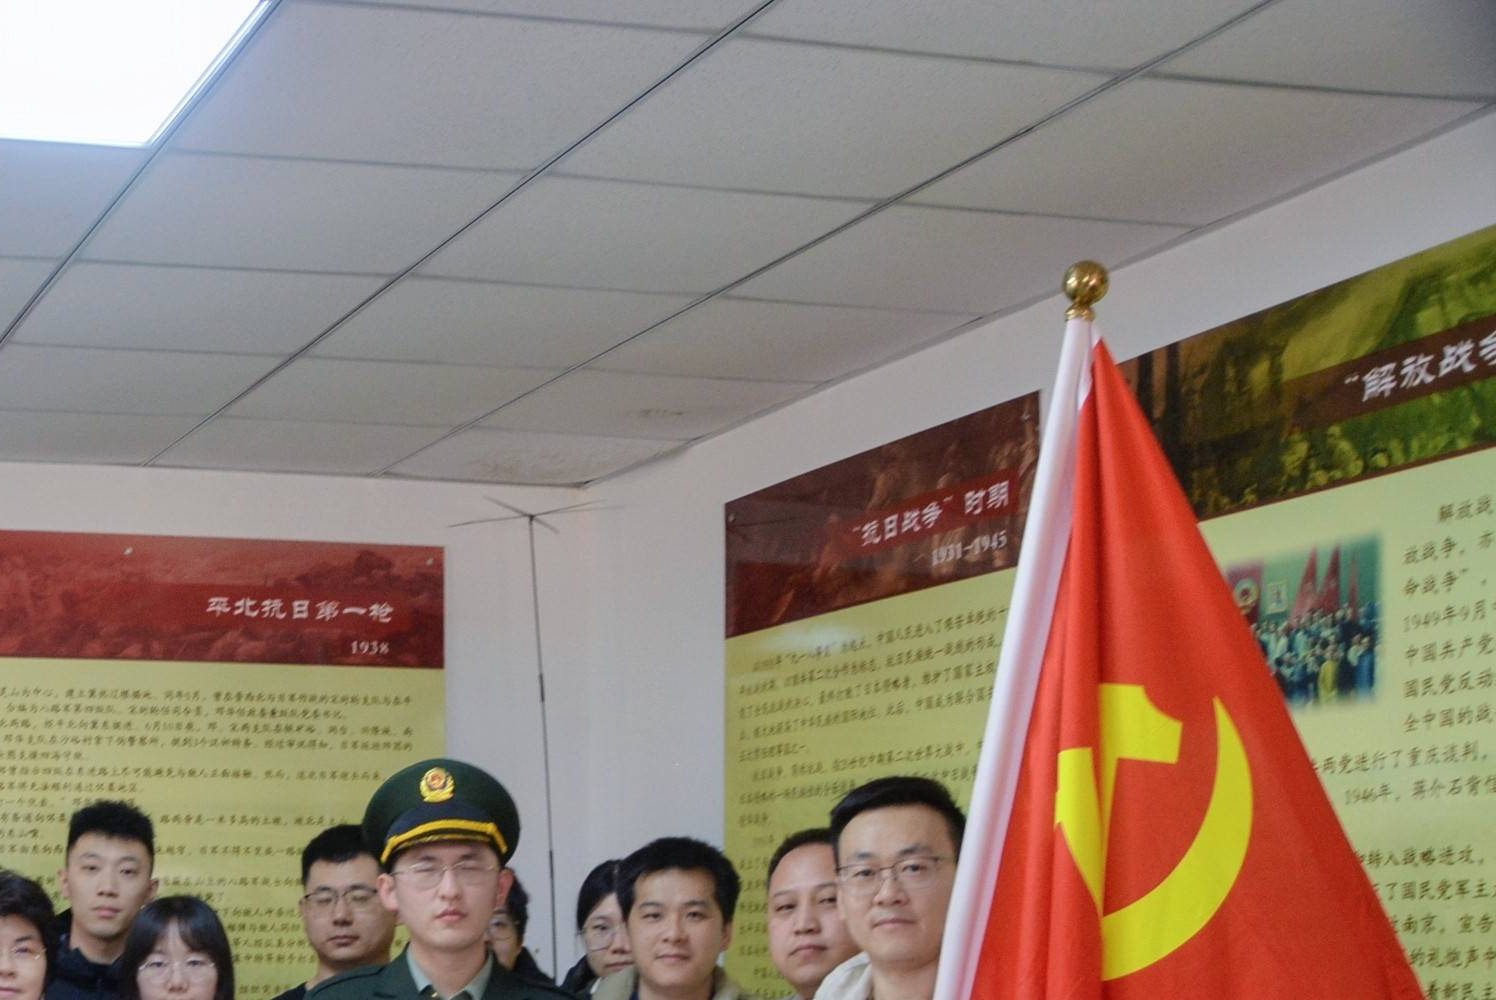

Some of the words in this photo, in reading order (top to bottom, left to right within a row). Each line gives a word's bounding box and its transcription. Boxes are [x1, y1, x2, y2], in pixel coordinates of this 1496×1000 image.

[206, 596, 394, 623] 平北抗日第一枪
[1403, 600, 1496, 632] 1949年9月
[350, 640, 390, 655] 1938
[1373, 879, 1496, 901] 了国民党军主
